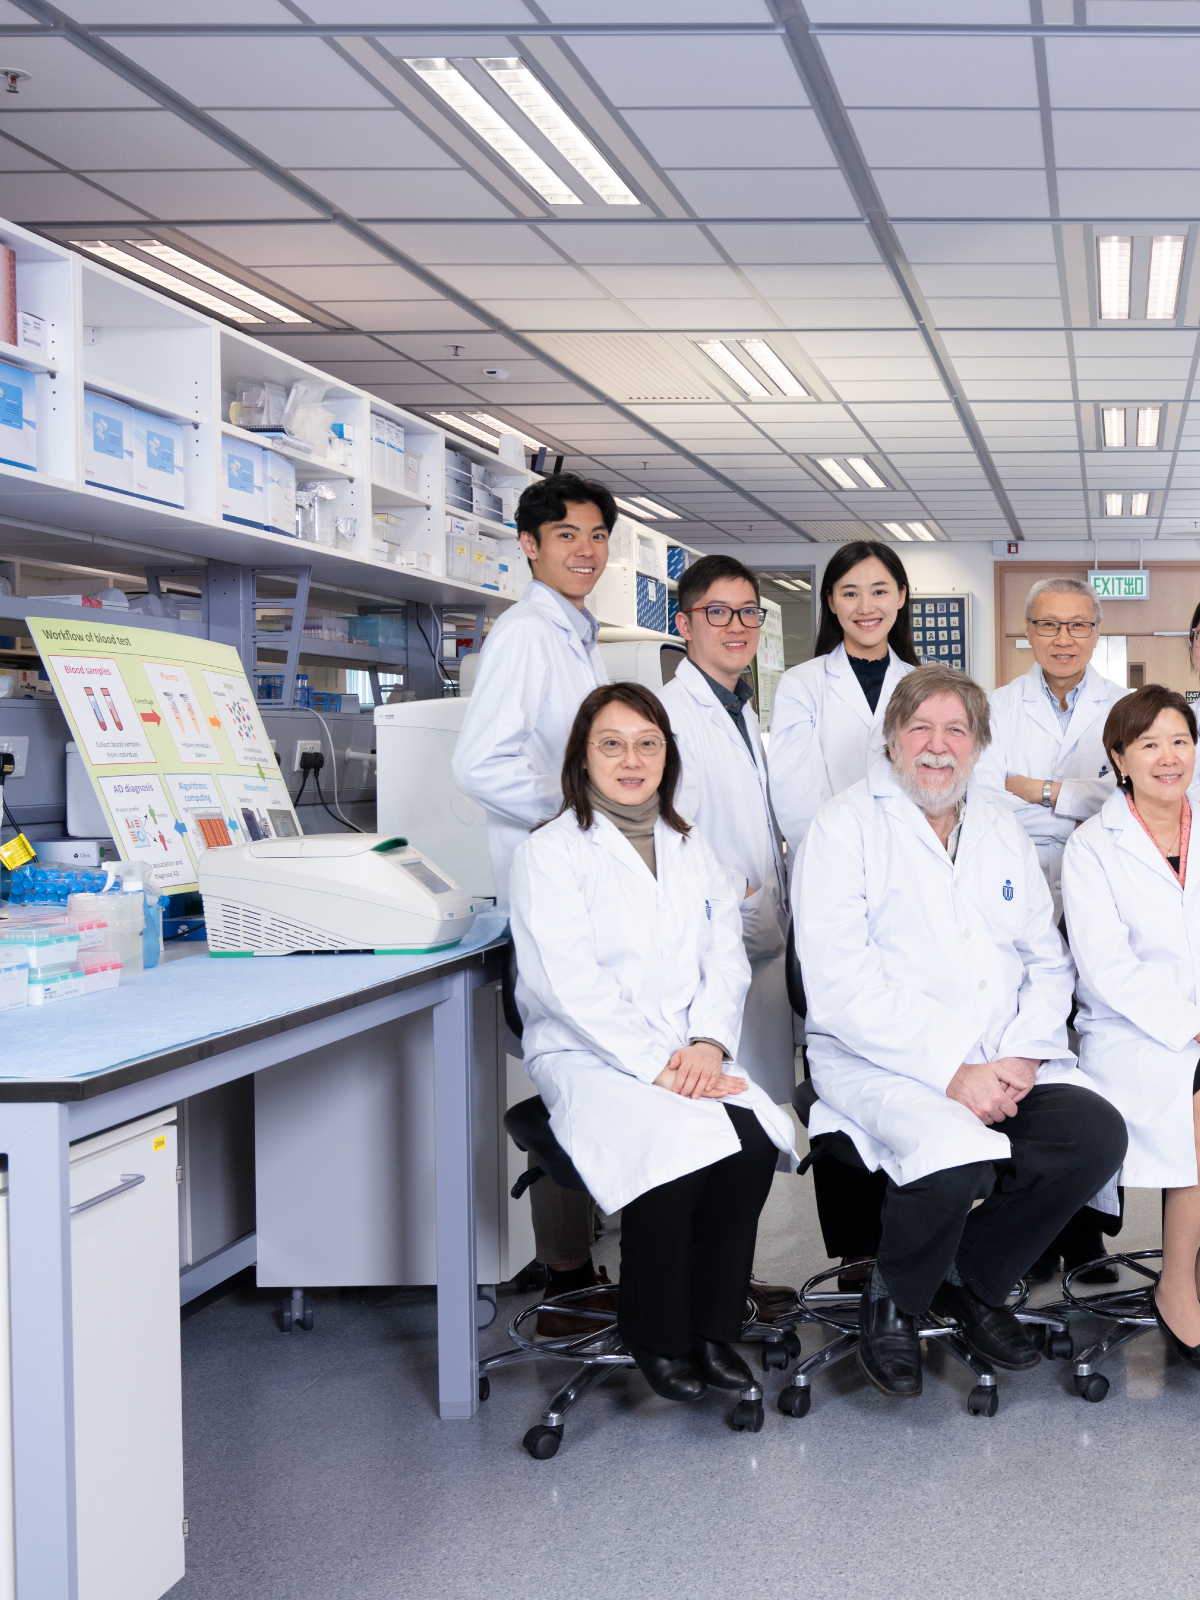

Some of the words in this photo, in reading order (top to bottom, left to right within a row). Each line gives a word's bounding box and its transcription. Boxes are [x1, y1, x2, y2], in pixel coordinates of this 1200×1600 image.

[1094, 577, 1123, 595] EXIT
[1124, 577, 1143, 595] 出口
[42, 629, 83, 641] Workflow
[85, 632, 93, 642] of
[95, 635, 115, 645] blood
[117, 636, 131, 646] test
[64, 665, 83, 674] Blood
[85, 668, 111, 676] samples
[159, 672, 178, 682] Plasma
[113, 785, 123, 793] AD
[125, 783, 154, 794] diagnosis
[178, 782, 208, 792] Algorithmic
[243, 783, 269, 792] Measurement
[184, 794, 212, 803] computing
